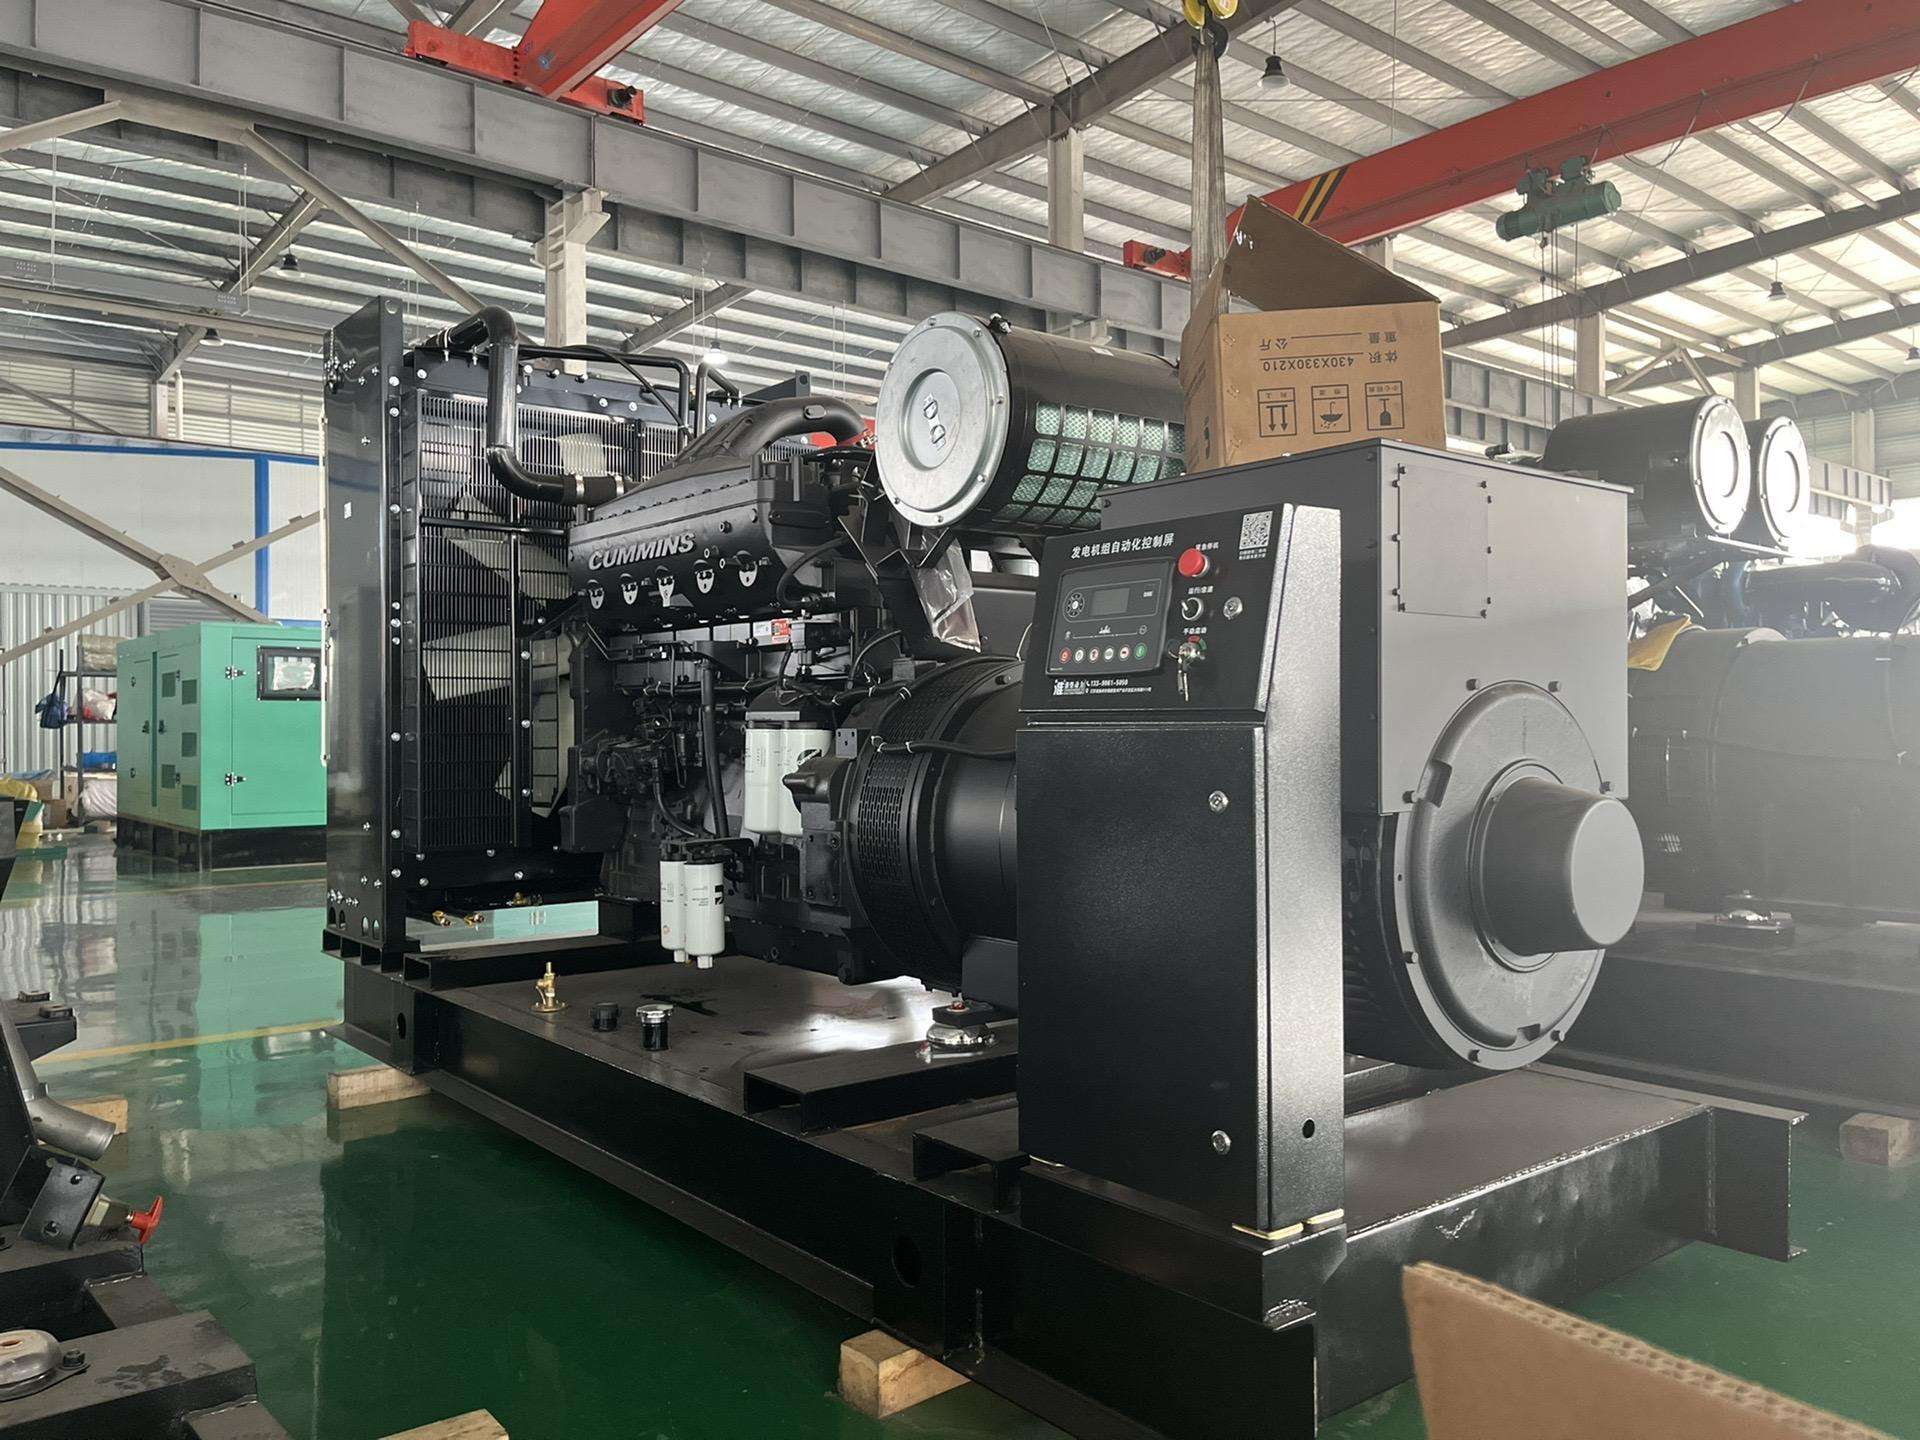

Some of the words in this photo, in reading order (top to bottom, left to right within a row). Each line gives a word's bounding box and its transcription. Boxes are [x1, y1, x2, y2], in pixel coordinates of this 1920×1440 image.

[1258, 337, 1288, 351] 公斤
[1262, 356, 1355, 372] 430X330X210
[1367, 350, 1398, 364] 体积
[588, 532, 696, 570] CUMMINS
[1071, 532, 1175, 560] 发电机组自动化控制屏
